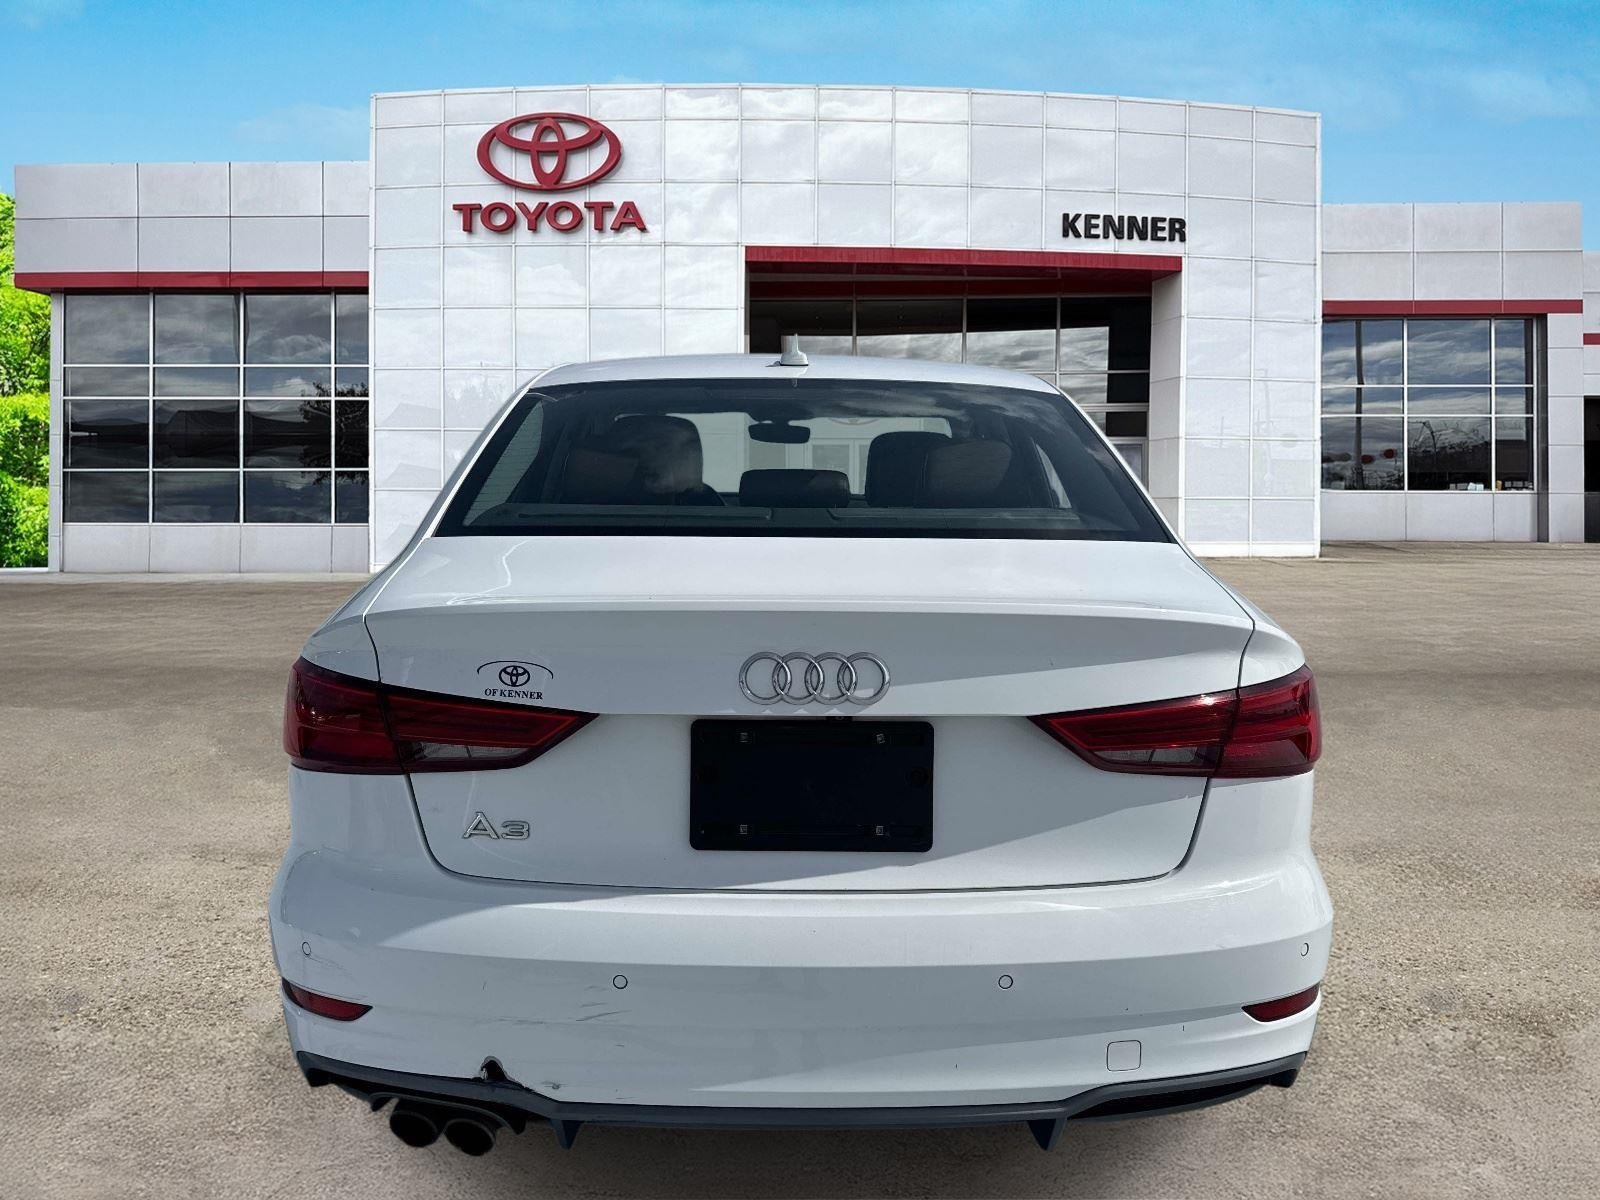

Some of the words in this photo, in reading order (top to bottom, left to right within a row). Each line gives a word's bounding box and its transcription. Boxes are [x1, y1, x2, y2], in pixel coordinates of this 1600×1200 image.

[452, 201, 647, 232] TOYOTA
[1061, 213, 1187, 242] KENNER
[484, 687, 499, 697] OF
[500, 689, 543, 700] KENNER
[461, 811, 530, 840] A3
